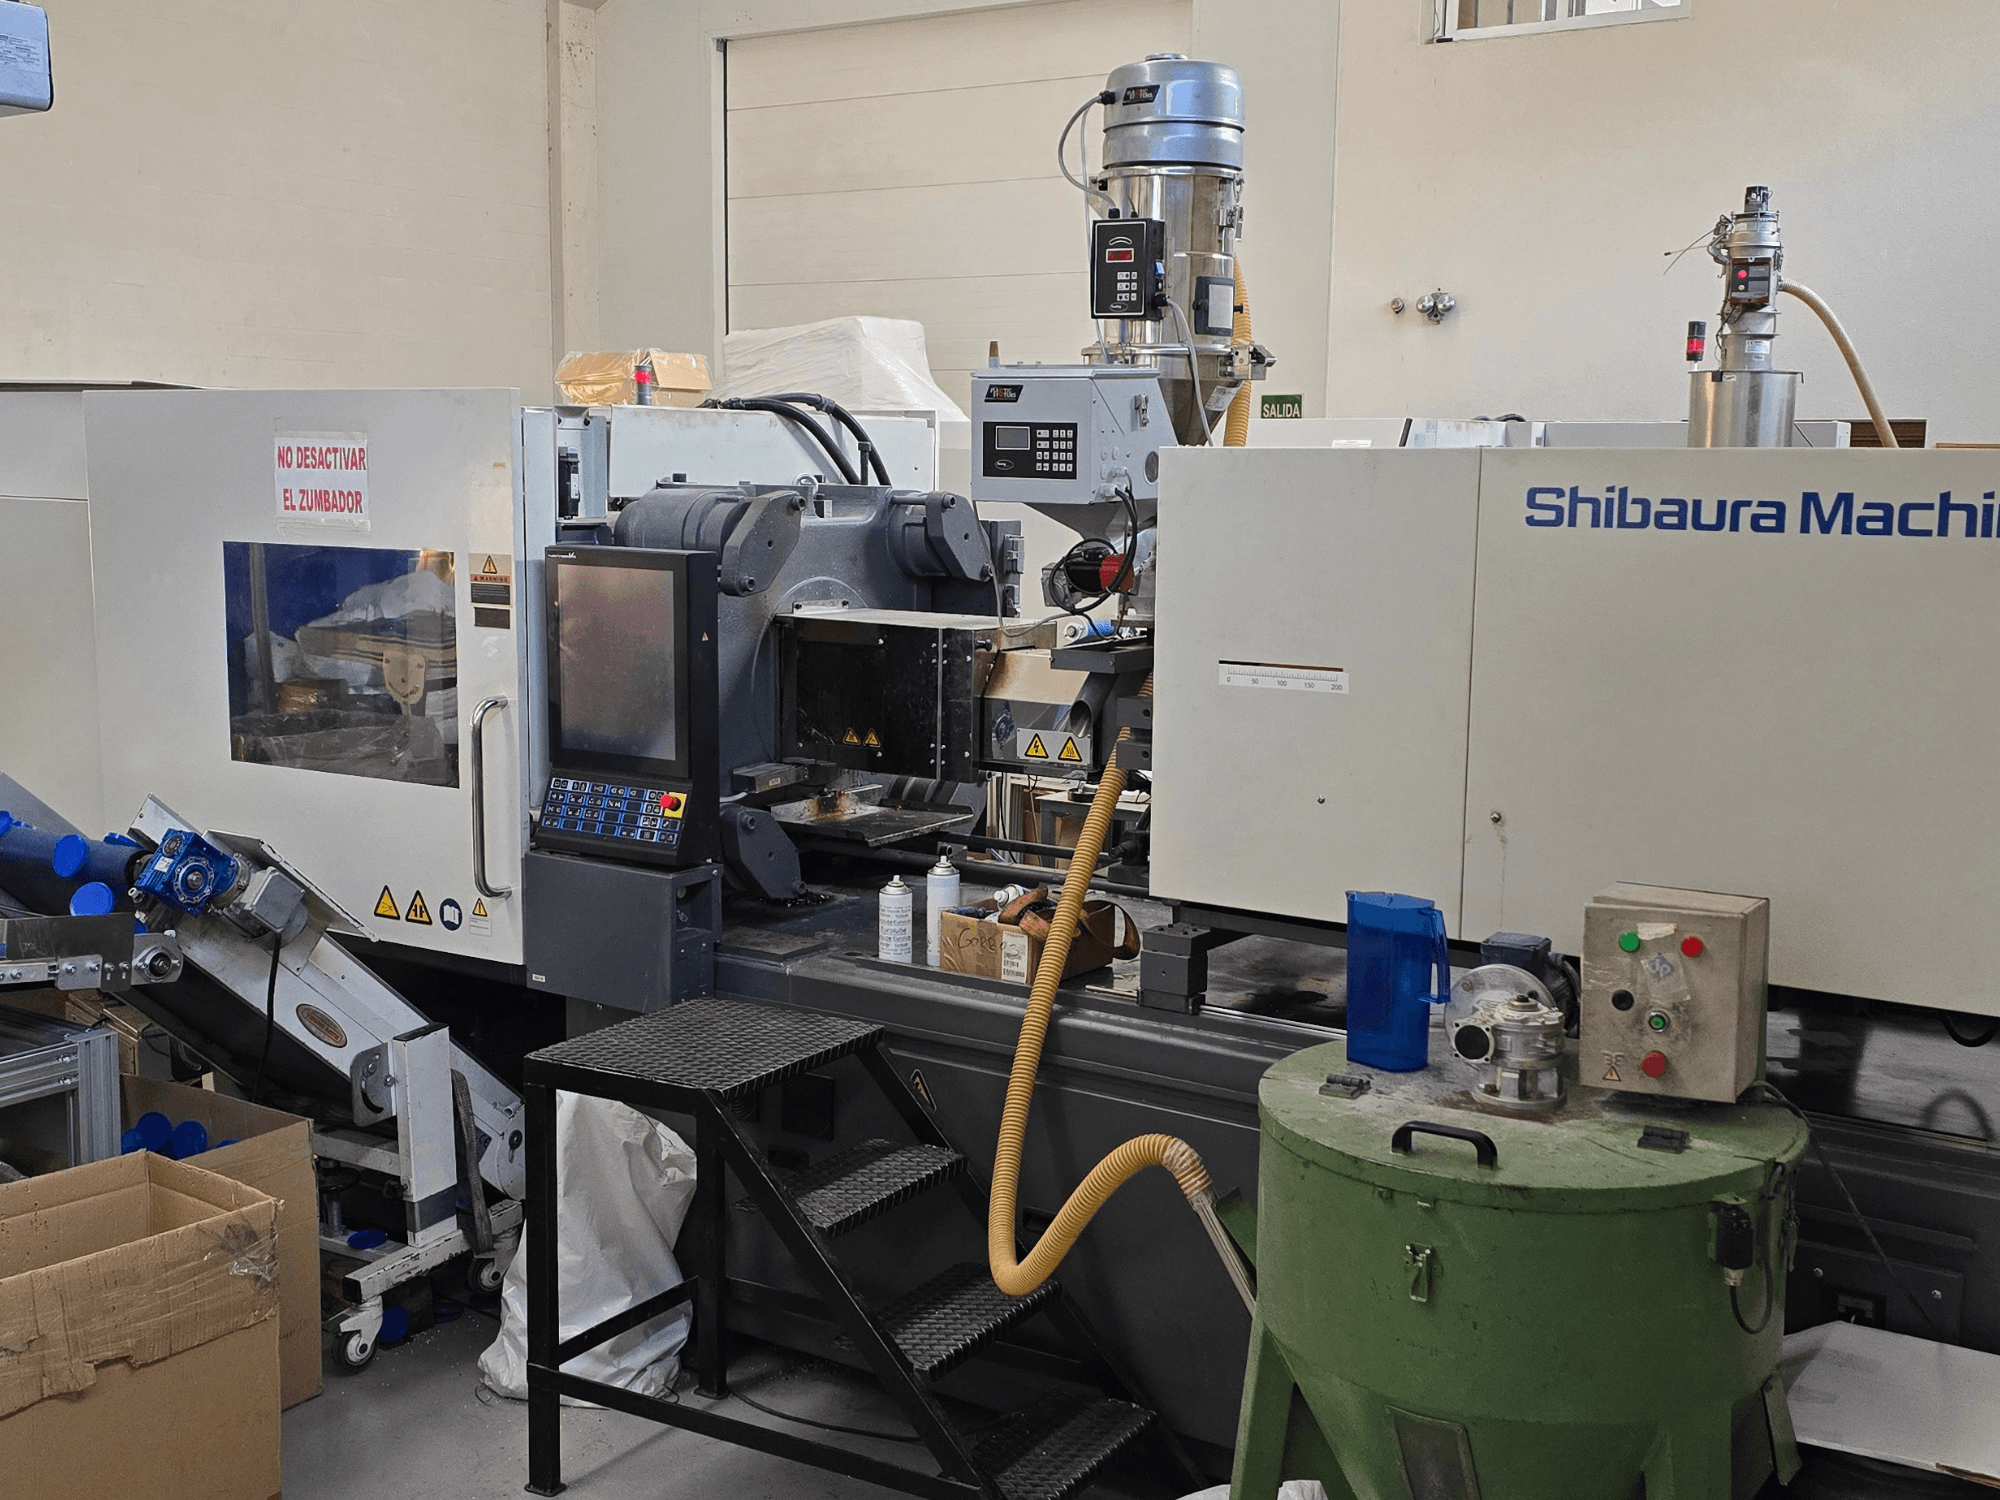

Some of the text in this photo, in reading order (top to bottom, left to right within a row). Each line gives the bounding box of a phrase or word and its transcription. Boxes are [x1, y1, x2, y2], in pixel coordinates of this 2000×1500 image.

[1263, 403, 1300, 418] SALIDA
[277, 445, 366, 470] NO DESACTIVAR
[283, 488, 363, 513] EL ZUMBADOR
[1525, 485, 2000, 538] Shibaura Machi
[1331, 683, 1343, 691] 200
